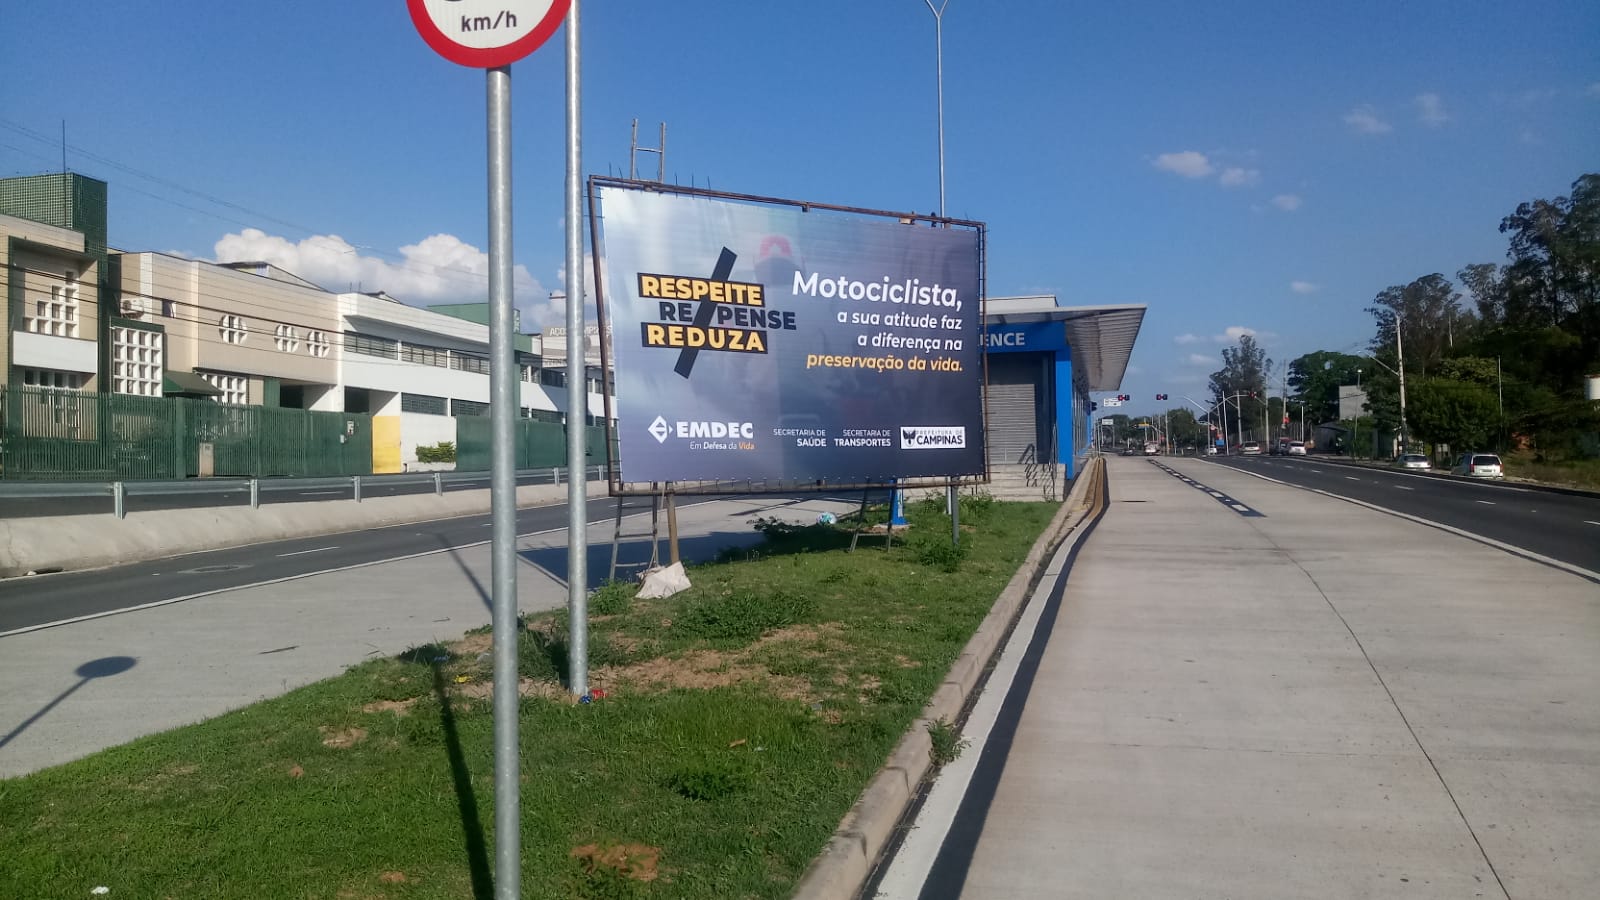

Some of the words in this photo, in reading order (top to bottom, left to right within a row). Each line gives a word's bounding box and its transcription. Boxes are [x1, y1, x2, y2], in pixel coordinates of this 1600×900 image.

[461, 10, 517, 32] km/h
[641, 275, 762, 306] RESPEITE
[792, 270, 962, 312] Motociclista,
[837, 311, 848, 323] a
[851, 312, 880, 325] sua
[884, 311, 938, 329] atitude
[941, 314, 962, 330] faz
[647, 324, 766, 352] REDUZA
[857, 334, 867, 346] a
[871, 332, 941, 354] diferença
[944, 338, 962, 351] na
[806, 353, 904, 373] preservação
[907, 355, 926, 371] da
[930, 356, 963, 372] vida.
[676, 421, 754, 439] EMDEC
[773, 428, 815, 436] SECRETARIA
[842, 429, 882, 437] SECRETARIA
[882, 429, 892, 437] DE
[689, 441, 702, 450] Em
[703, 441, 727, 450] Defesa
[728, 442, 737, 450] da
[738, 441, 755, 450] Vida
[796, 436, 827, 447] SAÚDE
[833, 438, 892, 447] TRANSPORTES
[916, 435, 963, 445] CAMPINAS
